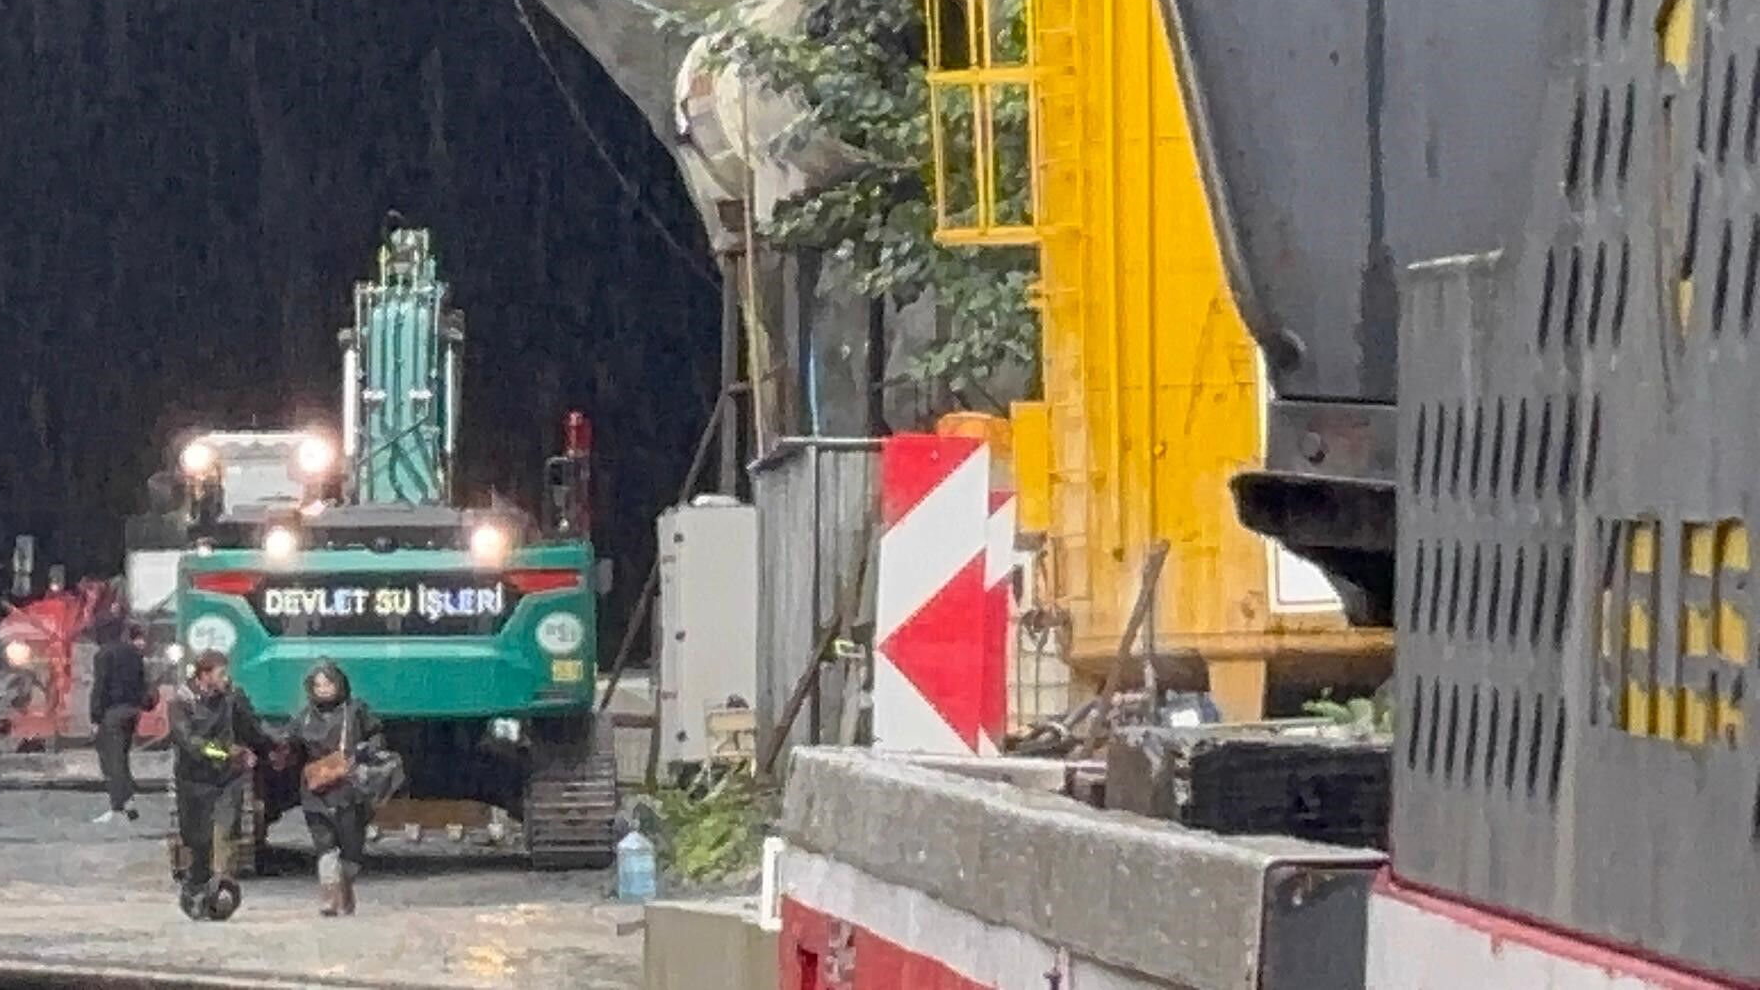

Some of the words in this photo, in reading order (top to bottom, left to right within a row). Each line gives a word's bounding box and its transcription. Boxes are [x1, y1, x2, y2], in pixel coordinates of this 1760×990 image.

[265, 588, 369, 616] DEVLET
[375, 588, 411, 616] SU
[417, 581, 504, 623] İŞLERİ
